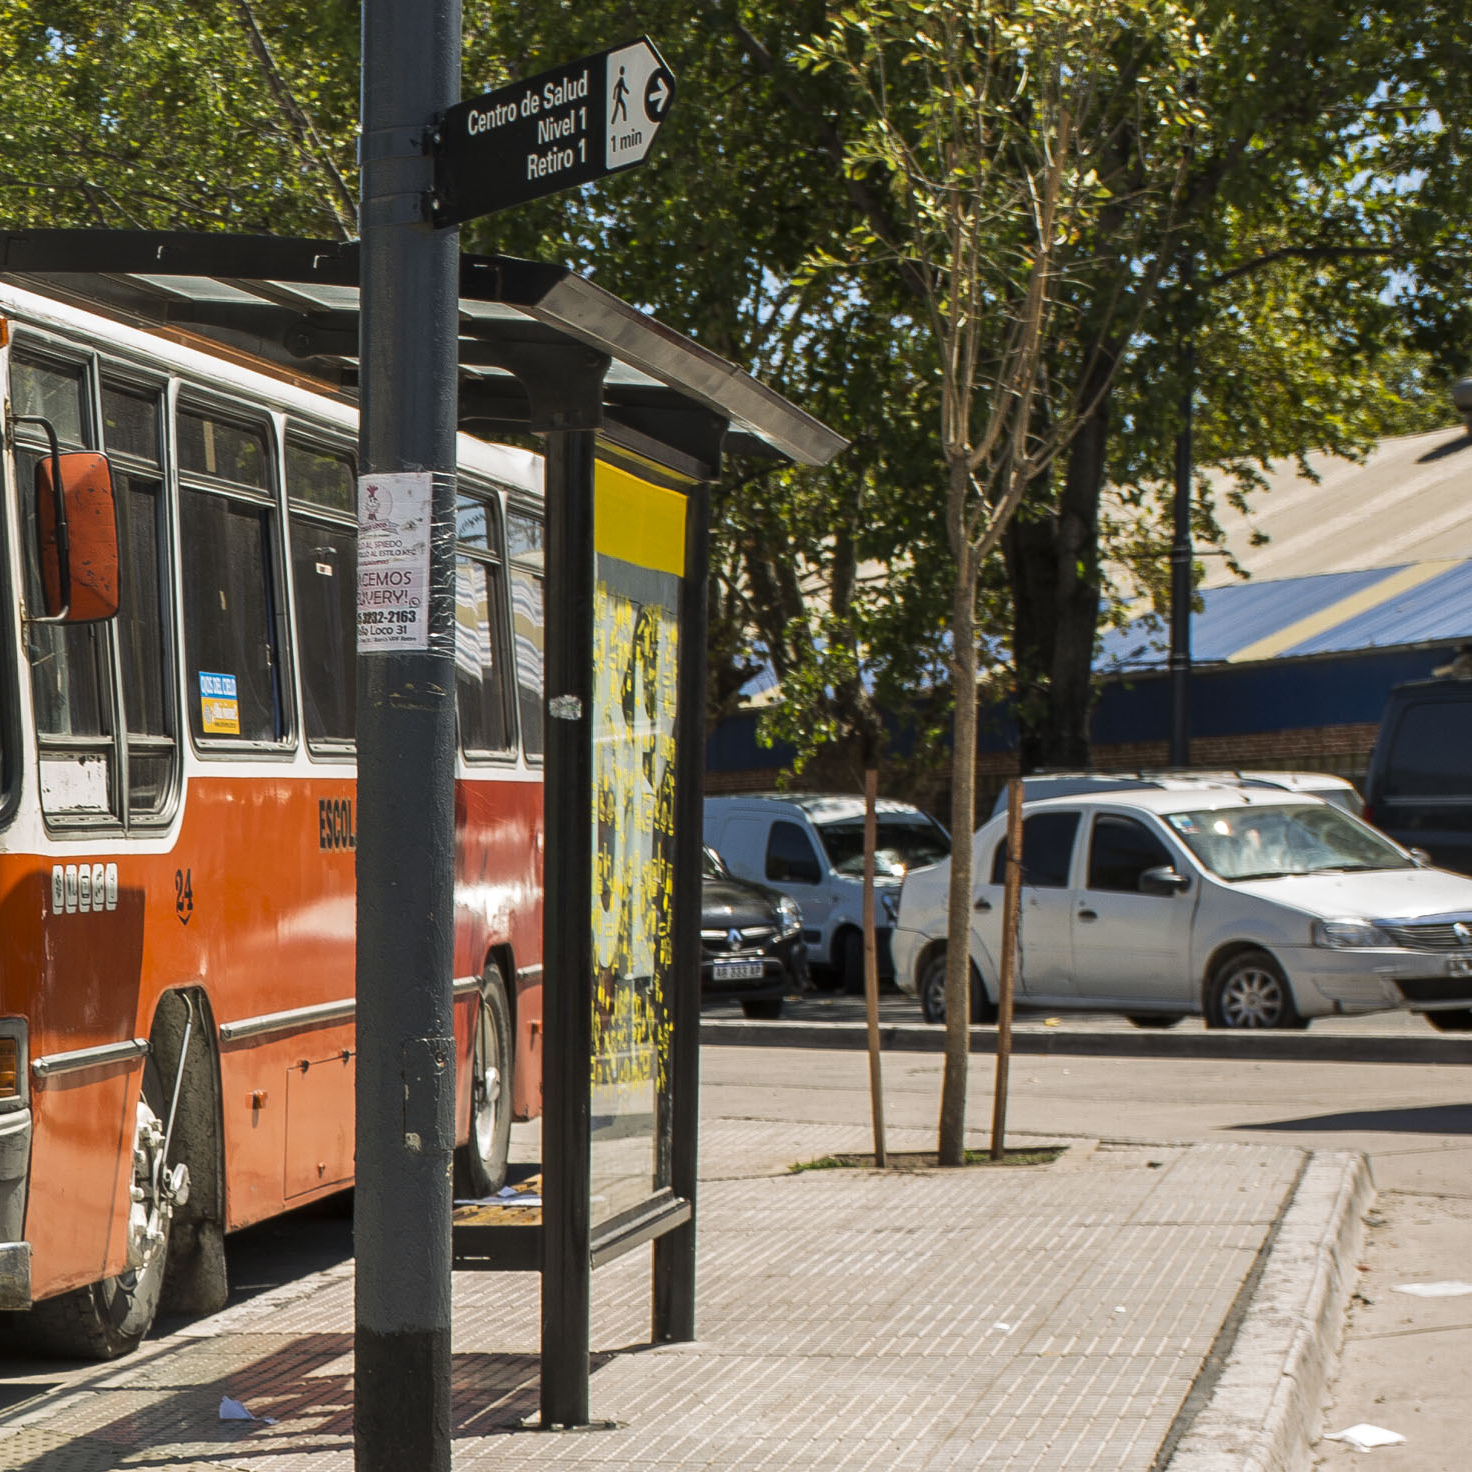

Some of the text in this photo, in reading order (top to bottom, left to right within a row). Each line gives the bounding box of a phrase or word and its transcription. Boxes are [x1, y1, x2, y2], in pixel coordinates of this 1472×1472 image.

[467, 69, 589, 136] Centro de Salud
[537, 106, 588, 145] Nivel 1
[610, 128, 643, 153] 1 min
[526, 138, 587, 181] Retiro 1
[359, 571, 412, 587] CEMOS
[174, 867, 195, 913] 24
